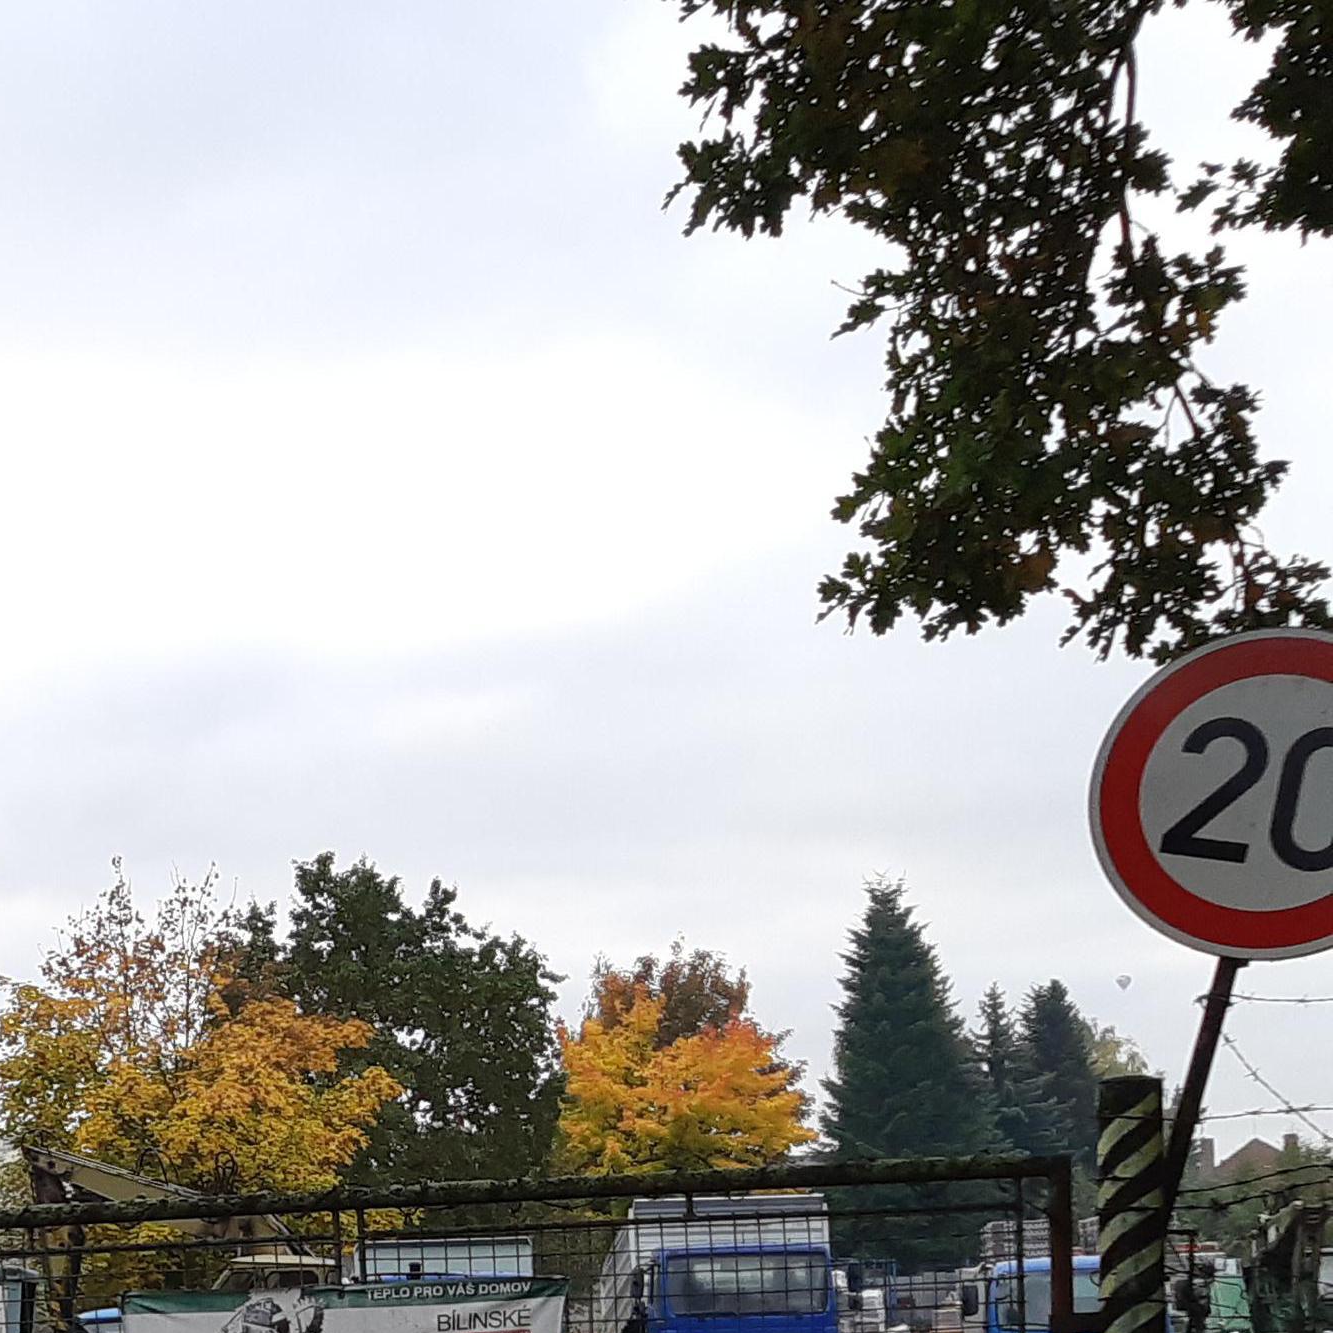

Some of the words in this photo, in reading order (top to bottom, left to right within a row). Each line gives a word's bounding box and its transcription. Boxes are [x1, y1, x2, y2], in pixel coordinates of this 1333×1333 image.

[1160, 717, 1333, 872] 20
[367, 1287, 410, 1300] TEPLO
[414, 1285, 443, 1297] PRO
[447, 1282, 476, 1296] VÁŠ
[479, 1281, 532, 1294] DOMOV
[437, 1304, 532, 1332] BÍLINSKÉ
